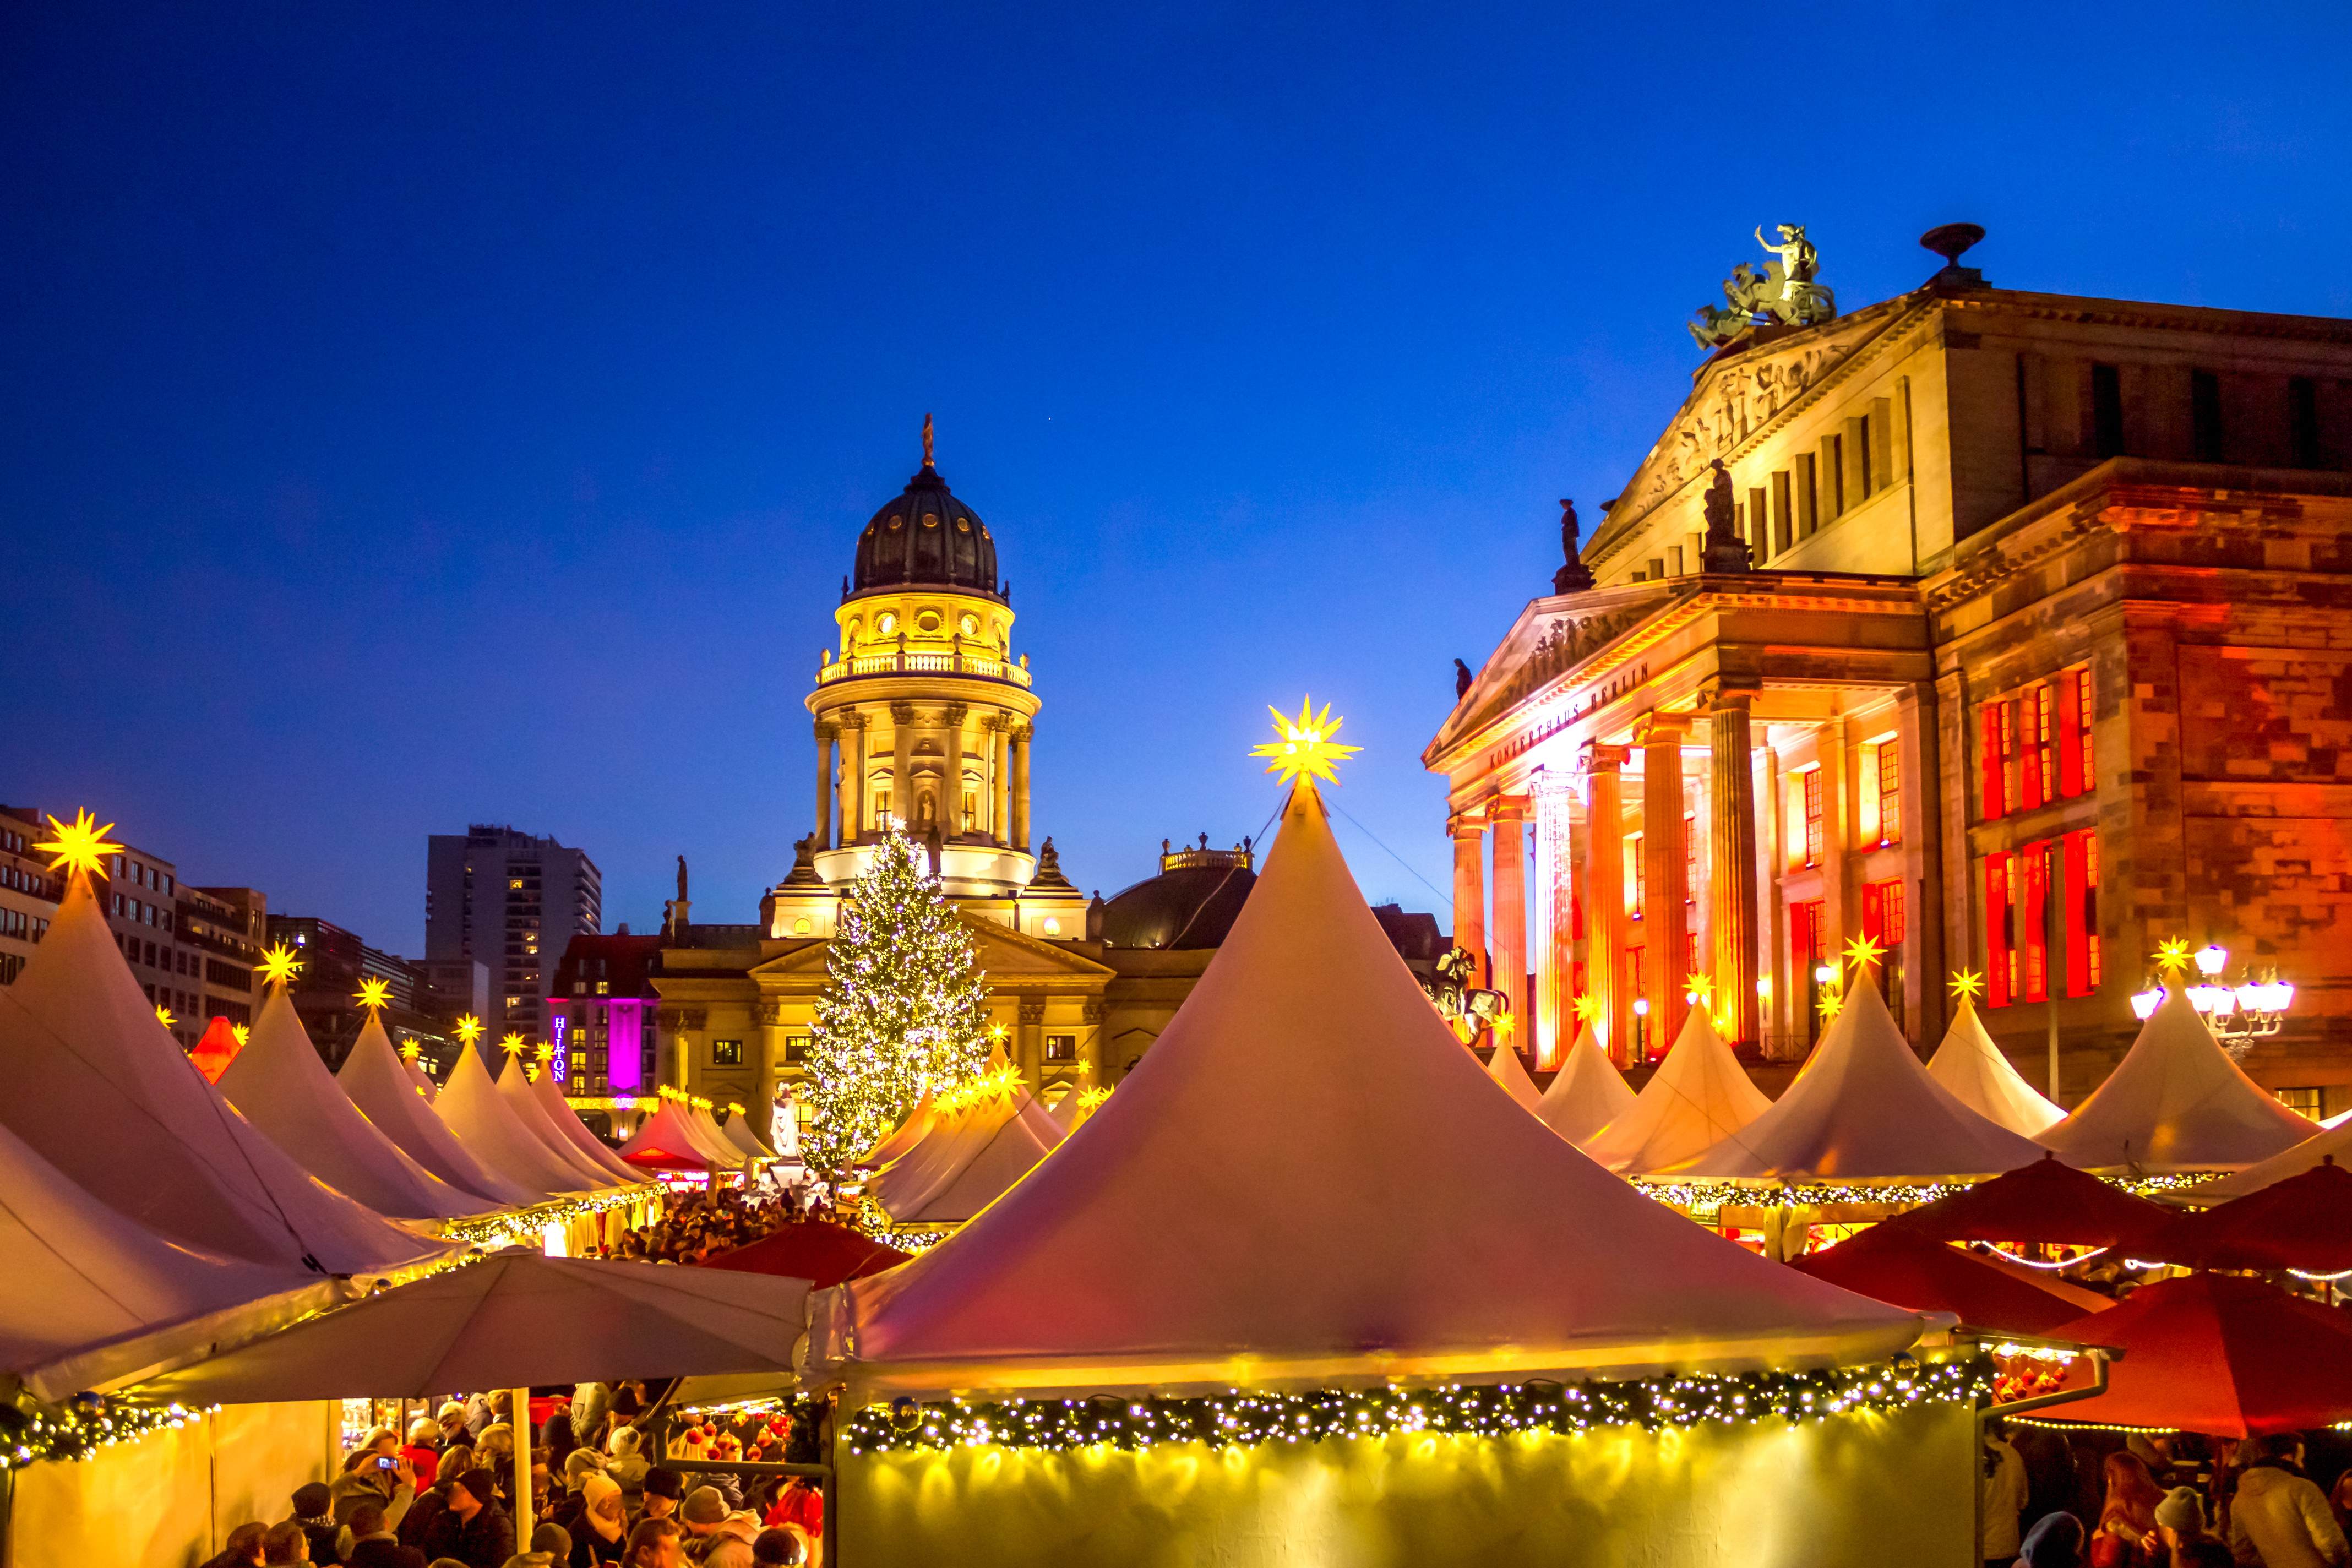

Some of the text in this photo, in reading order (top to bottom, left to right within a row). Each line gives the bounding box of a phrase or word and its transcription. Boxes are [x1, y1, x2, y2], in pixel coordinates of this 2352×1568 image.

[1490, 661, 1648, 769] KONZERTHAUS BERLIN
[553, 1017, 565, 1081] HILTON
